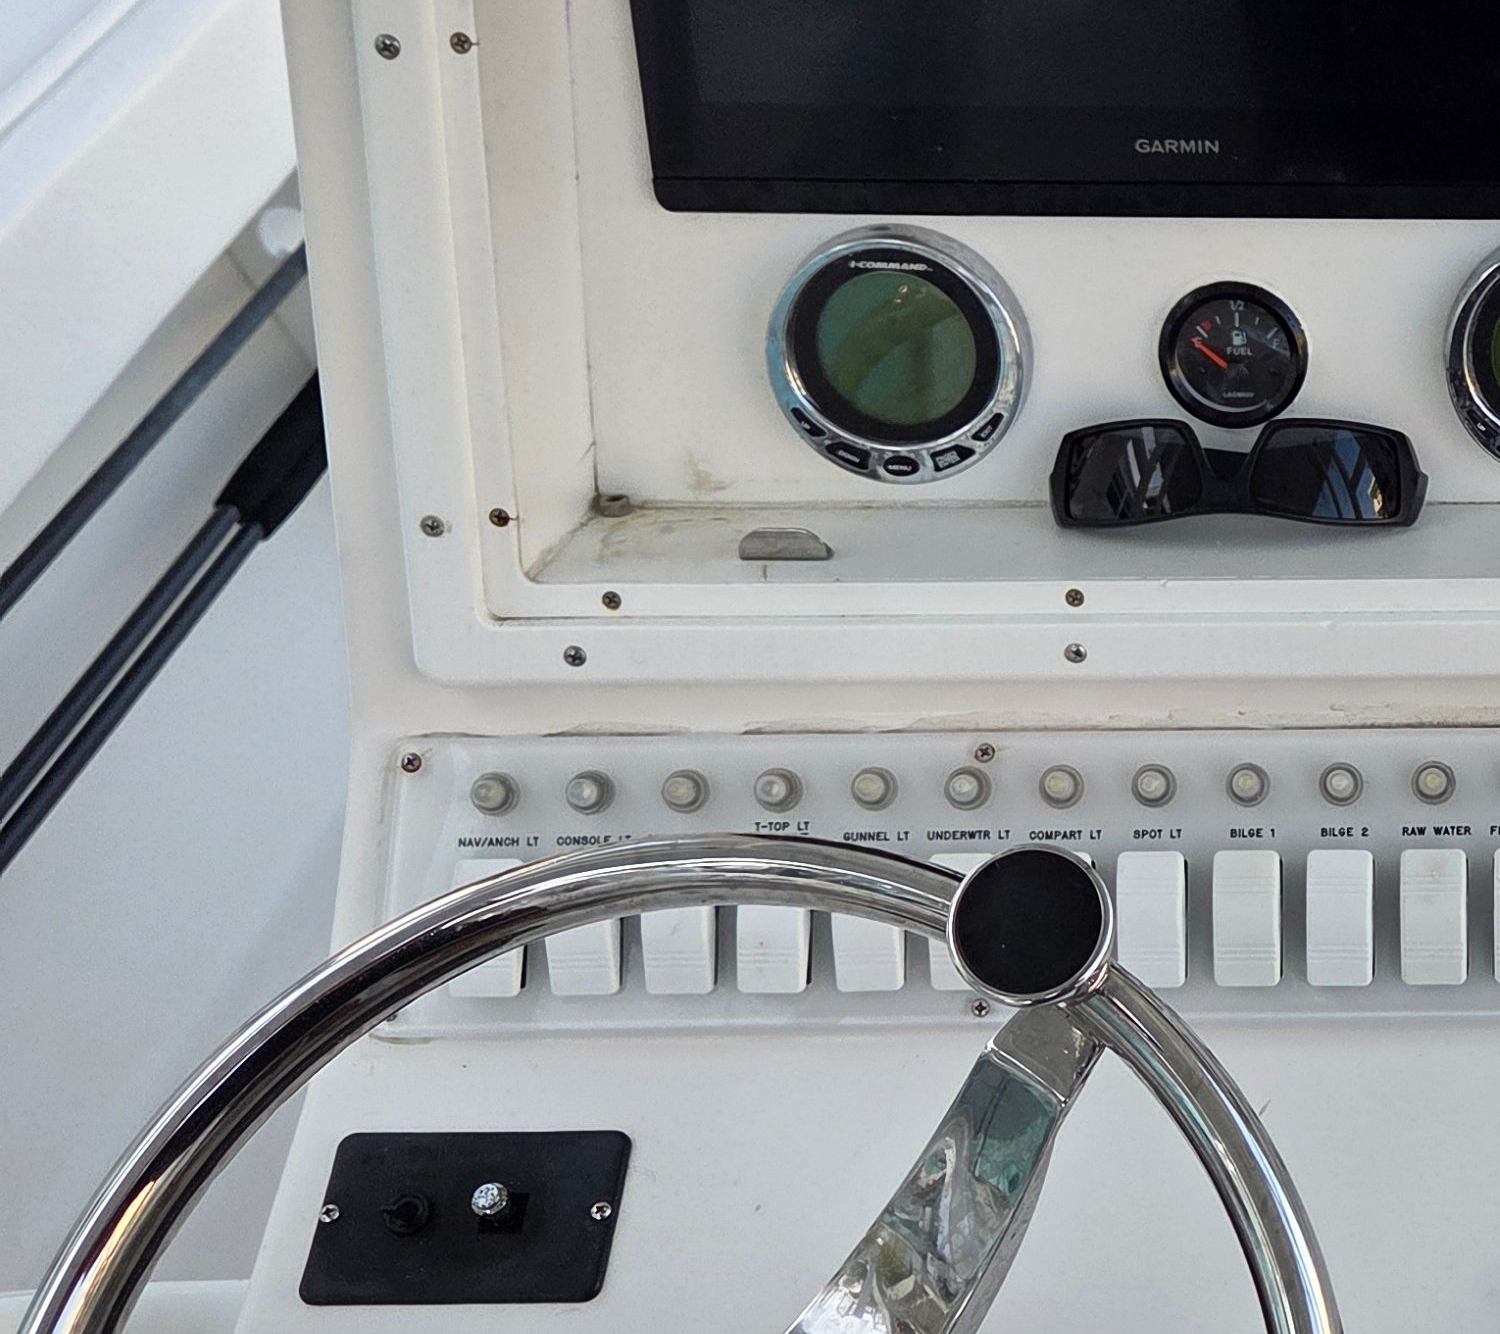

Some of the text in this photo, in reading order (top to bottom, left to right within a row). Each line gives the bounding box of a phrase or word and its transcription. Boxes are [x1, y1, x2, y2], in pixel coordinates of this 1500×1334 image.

[1134, 138, 1220, 154] GARMIN
[1226, 346, 1254, 357] FUEL
[754, 820, 811, 832] T-TOP LT
[1320, 826, 1370, 838] BILGE 2
[1401, 825, 1472, 836] RAW WATER
[843, 831, 910, 842] GUNNEL LT
[927, 829, 1011, 841] UNDERWTR LT
[1029, 829, 1103, 841] COMPART LT
[1132, 829, 1183, 840] SPOT LT
[1229, 827, 1277, 839] BILGE 1
[457, 836, 541, 848] NAV/ANCH LT
